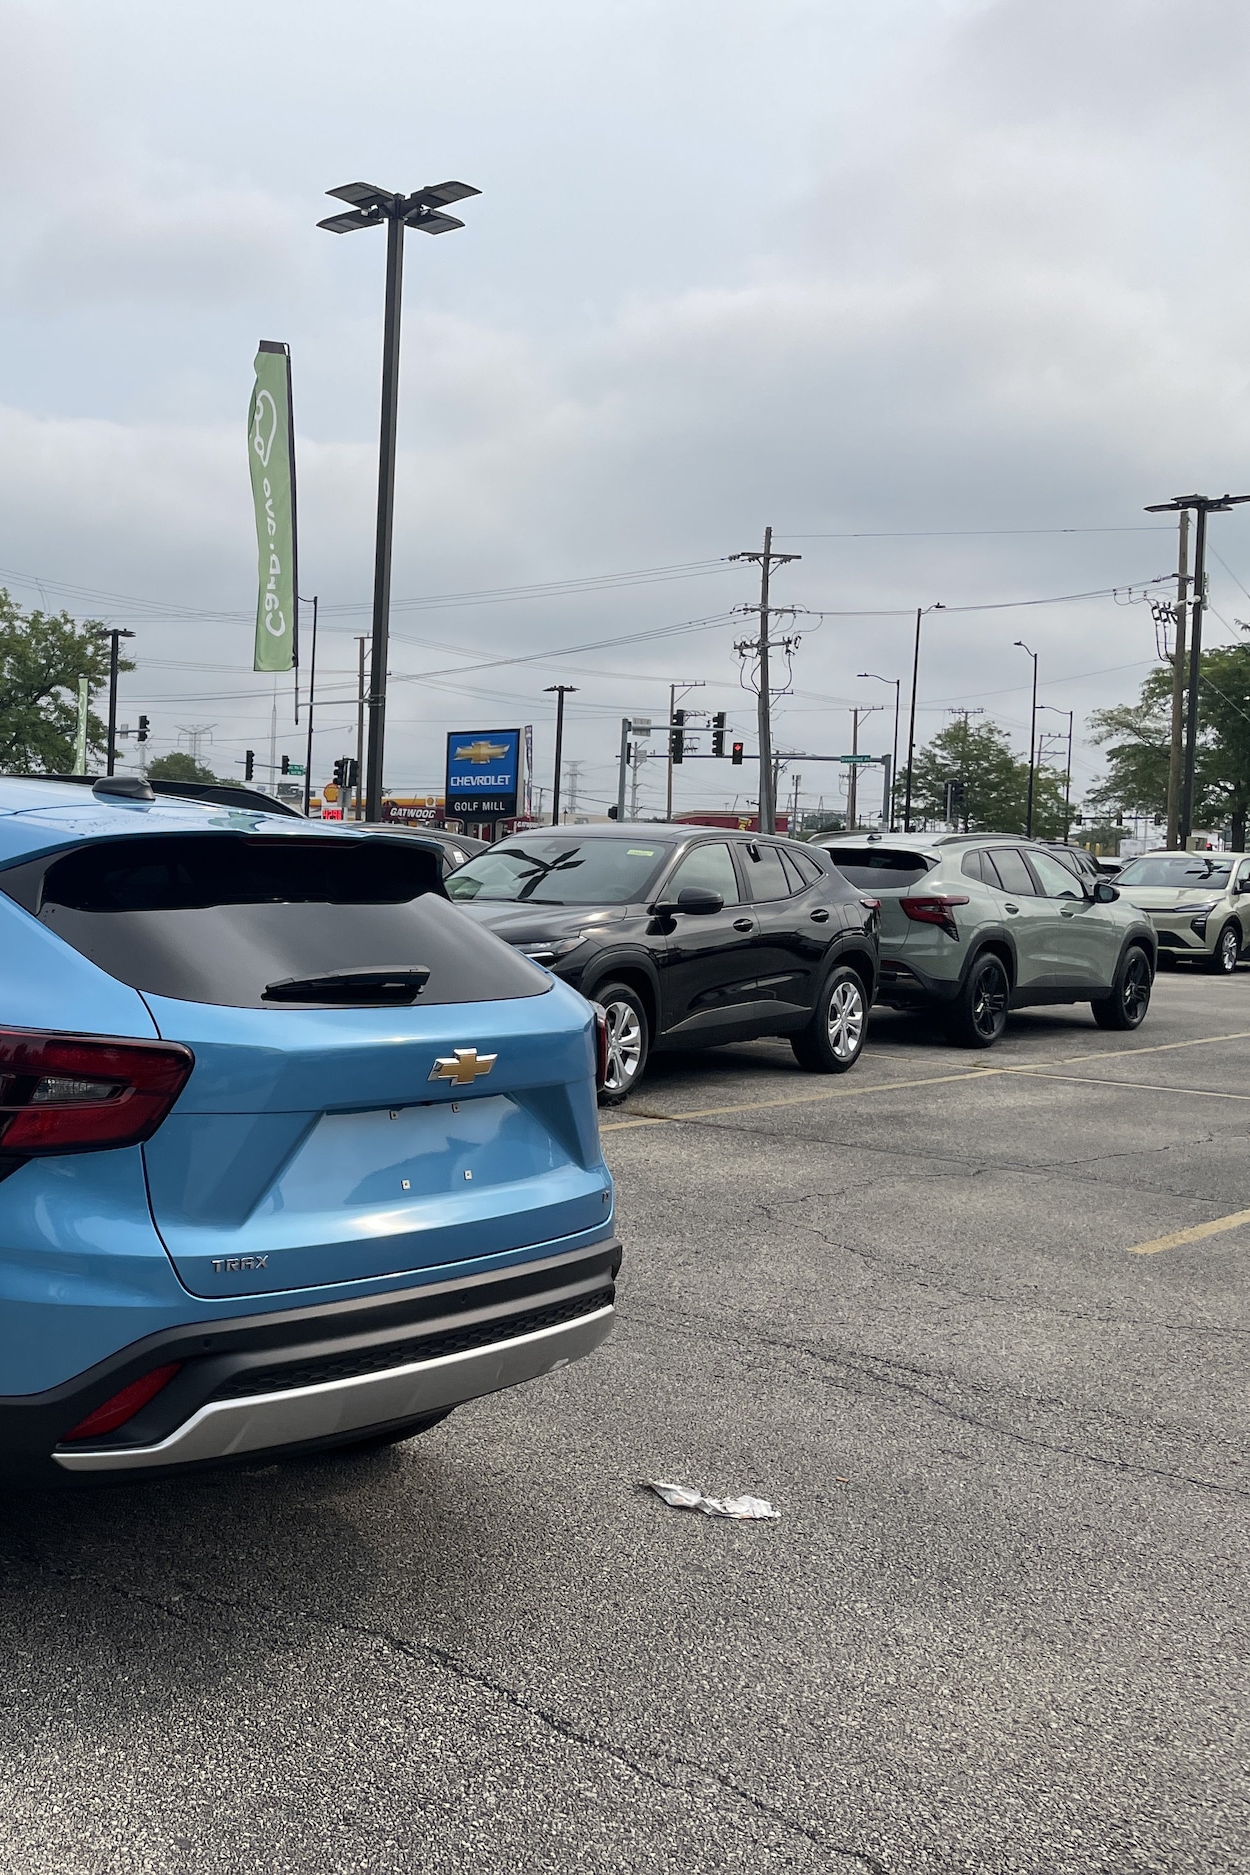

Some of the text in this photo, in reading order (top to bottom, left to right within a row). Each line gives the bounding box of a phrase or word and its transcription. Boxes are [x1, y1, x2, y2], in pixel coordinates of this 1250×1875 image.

[450, 774, 511, 787] CHEVROLET
[454, 801, 505, 811] GOLF MILL
[211, 1254, 269, 1273] TRAX
